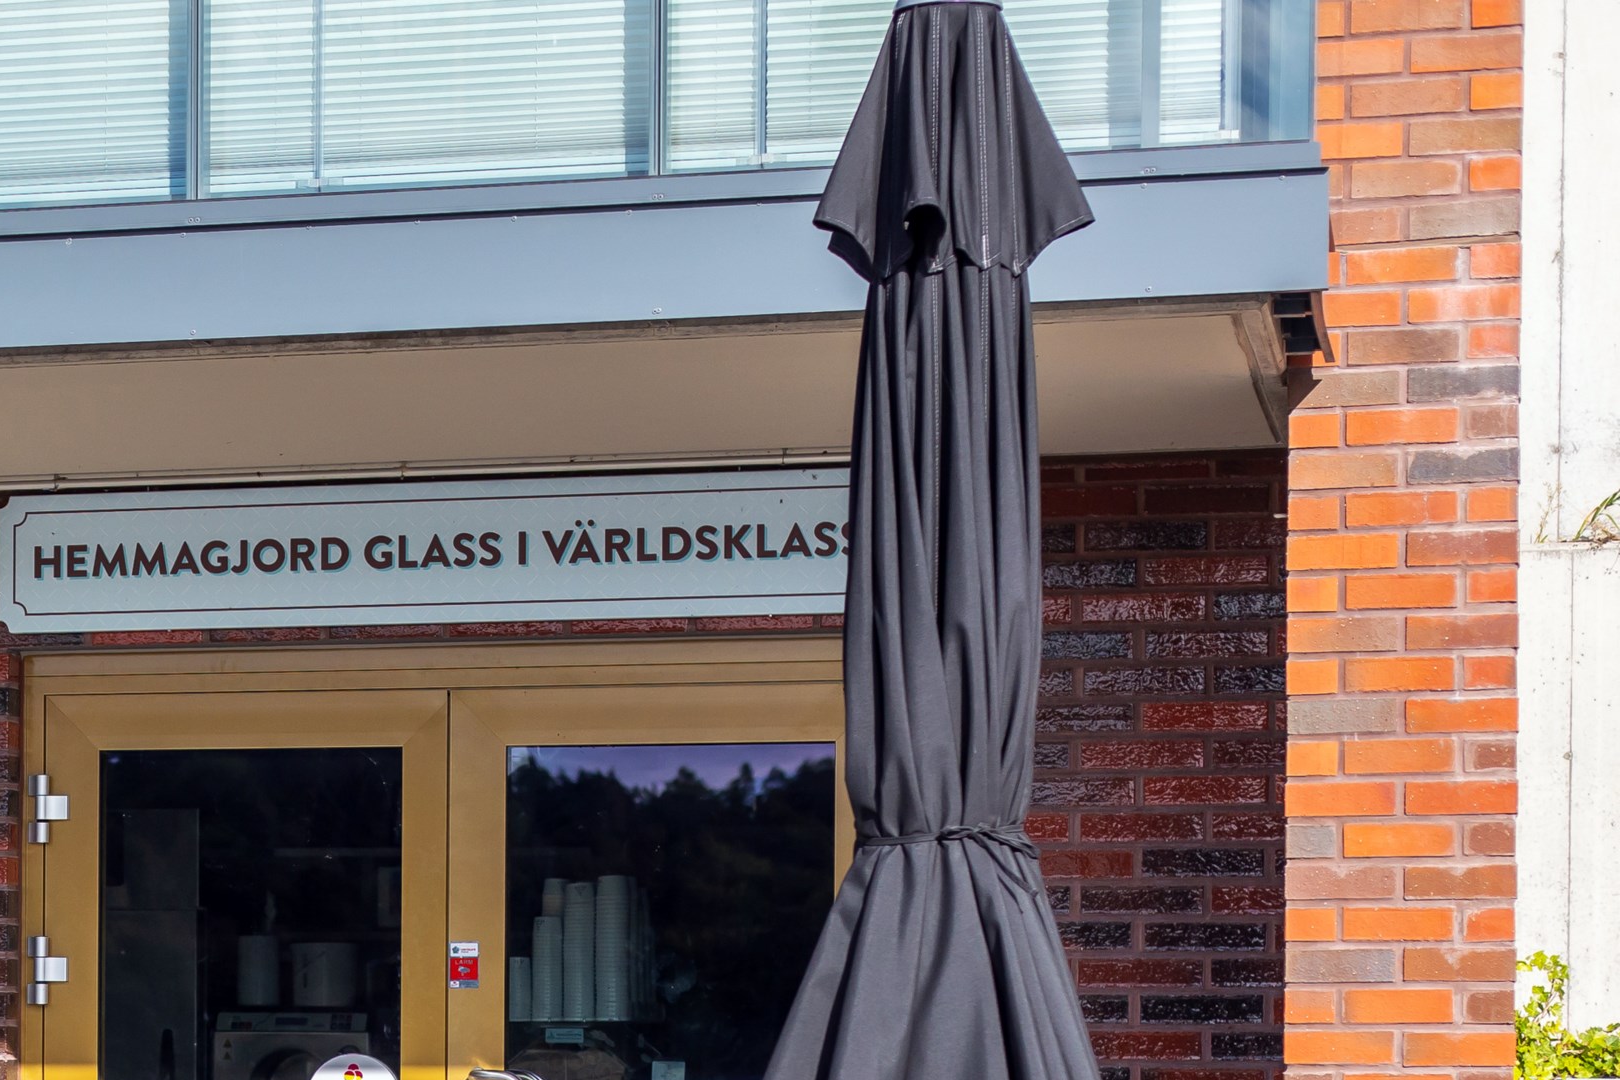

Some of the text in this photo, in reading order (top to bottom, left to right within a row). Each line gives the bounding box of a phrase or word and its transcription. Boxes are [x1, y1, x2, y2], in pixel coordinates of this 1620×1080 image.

[33, 537, 351, 580] HEMMAGJORD
[363, 531, 503, 571] GLASS
[518, 530, 528, 567] I
